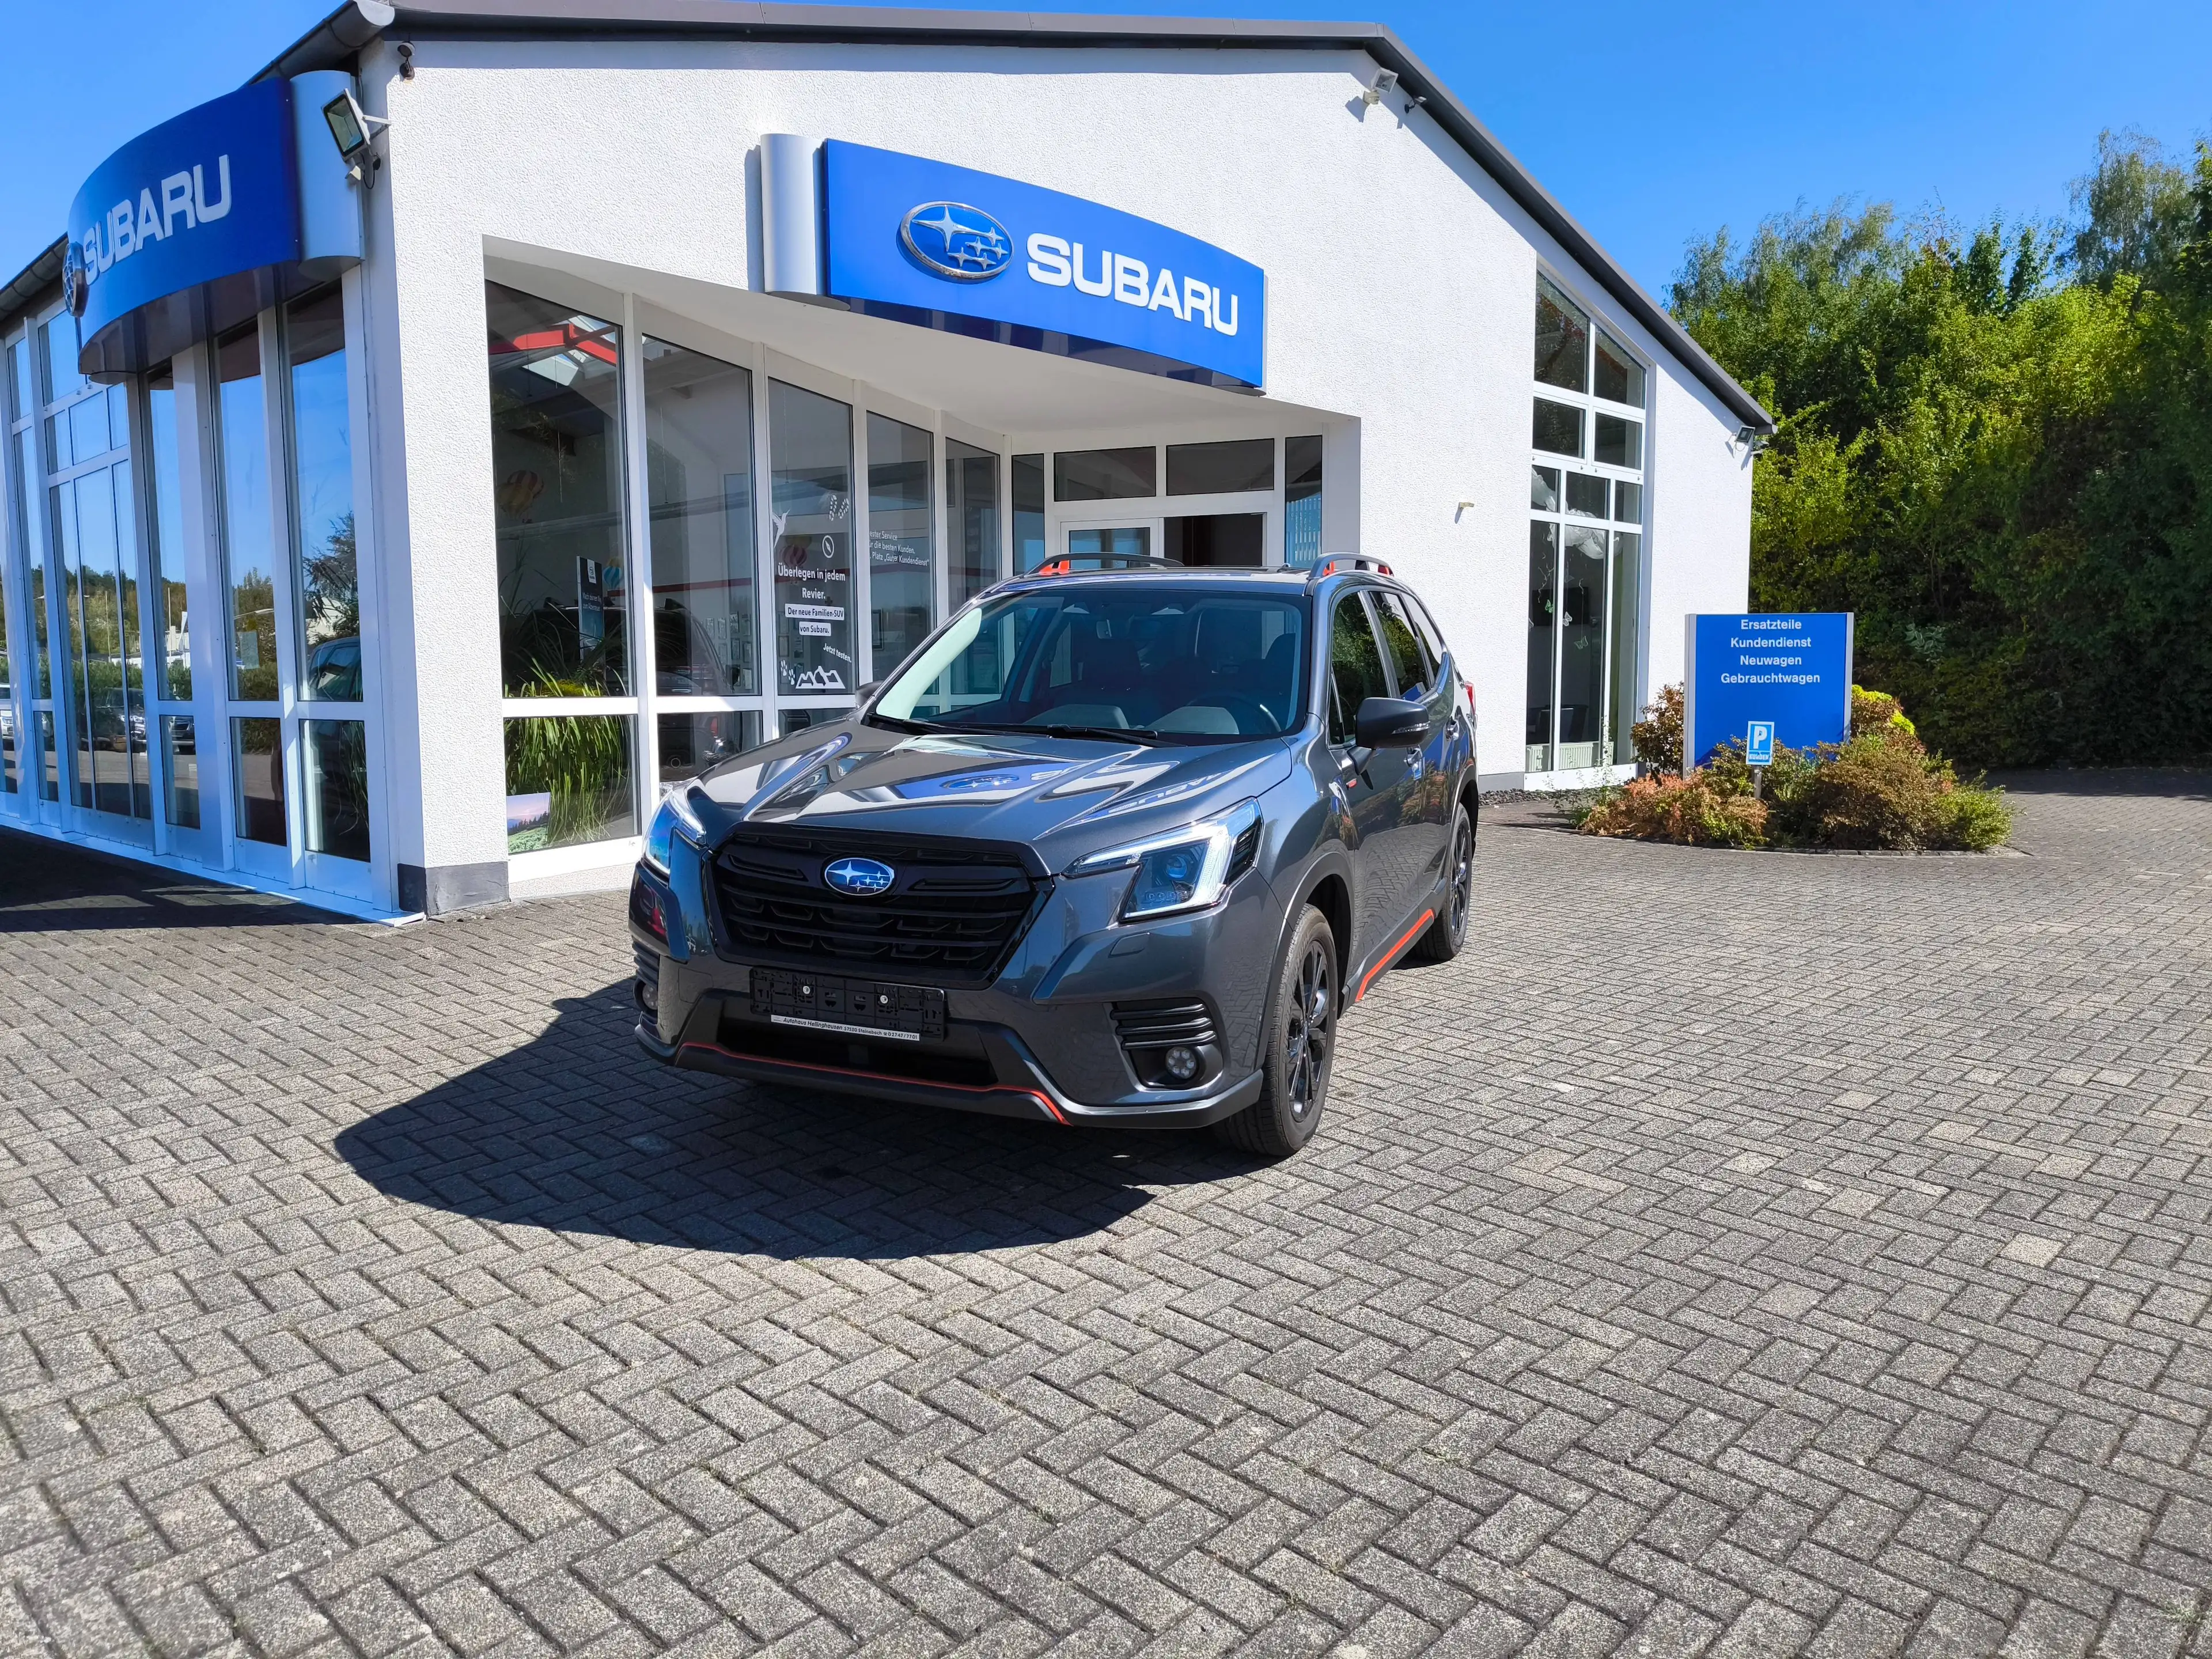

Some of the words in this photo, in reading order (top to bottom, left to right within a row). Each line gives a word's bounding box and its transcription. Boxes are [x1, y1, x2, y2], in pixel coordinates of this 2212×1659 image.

[83, 154, 232, 286] SUBARU
[1026, 233, 1238, 337] SUBARU
[869, 530, 881, 538] ester
[881, 531, 898, 541] Service
[882, 541, 897, 552] besten
[872, 551, 883, 560] Platz
[778, 562, 816, 581] Überlegen
[817, 568, 824, 579] in
[824, 569, 846, 582] jedem
[802, 587, 825, 599] Revier.
[787, 607, 797, 615] Der
[812, 608, 844, 618] Familien-SUV
[810, 625, 830, 634] Subaru.
[1741, 619, 1802, 630] Ersatzteile
[1730, 637, 1812, 648] Kundendienst
[823, 643, 835, 655] Jetzt
[836, 649, 852, 663] testen.
[1740, 655, 1802, 667] Neuwagen
[1721, 673, 1820, 685] Gebrauchtwagen
[1753, 725, 1767, 749] P
[783, 1017, 806, 1025] Autohaus
